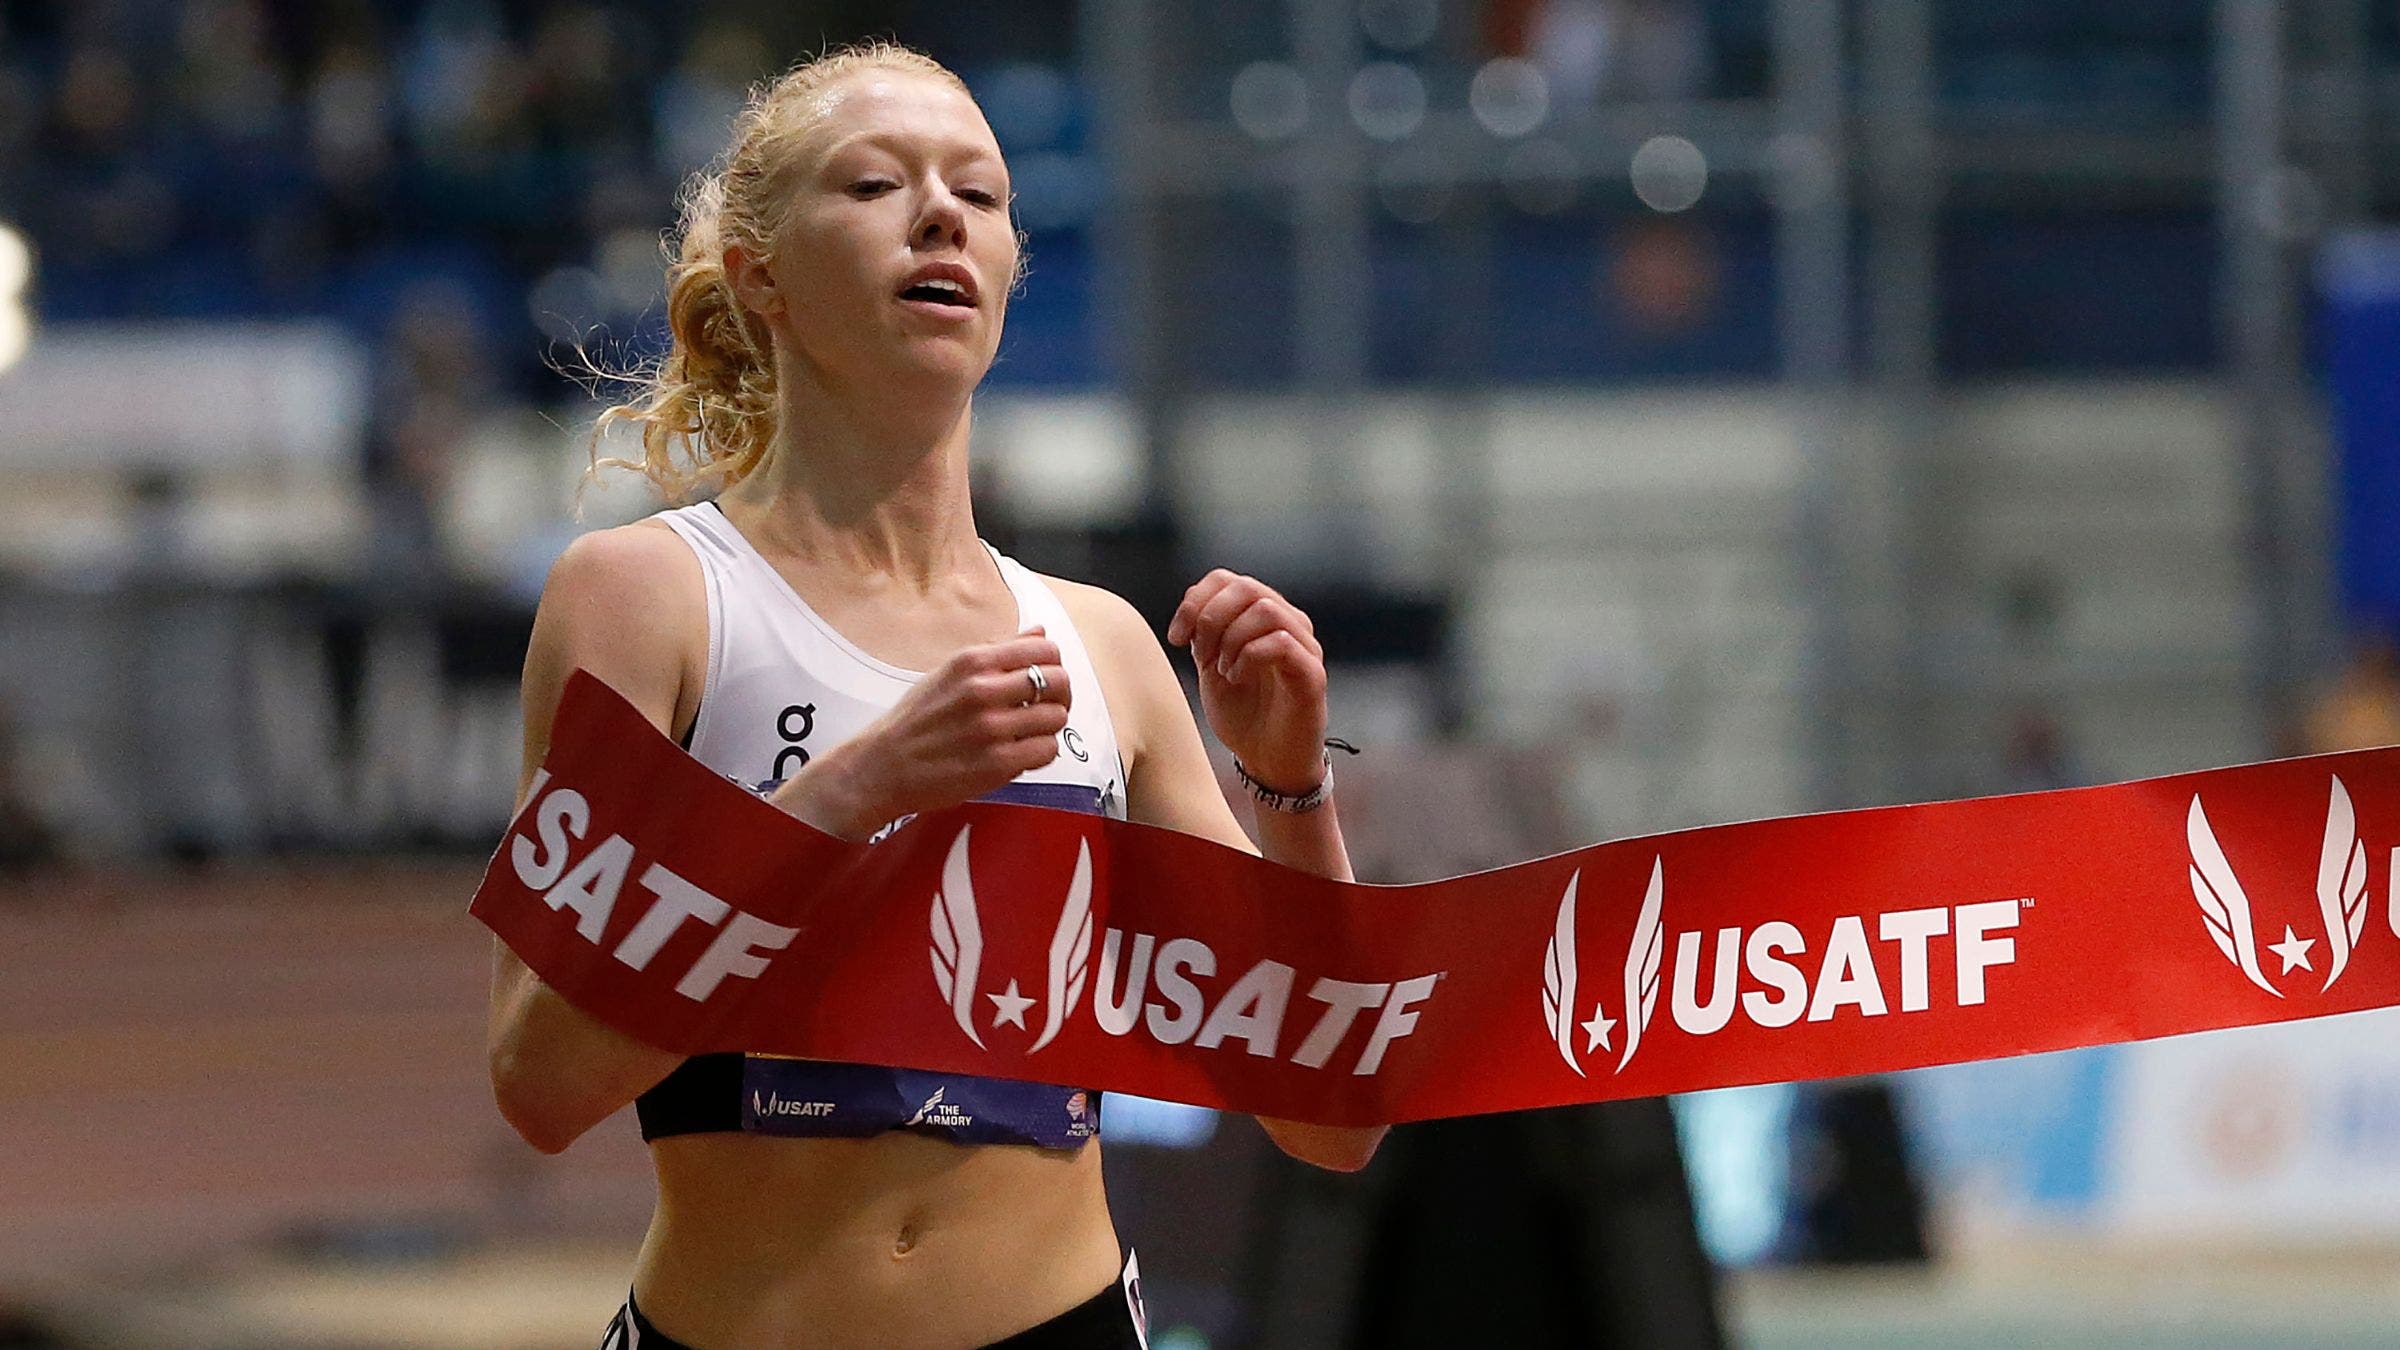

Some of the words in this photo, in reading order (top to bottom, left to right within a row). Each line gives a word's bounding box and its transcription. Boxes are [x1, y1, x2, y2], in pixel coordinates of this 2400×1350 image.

[511, 766, 801, 1003] SATF
[1094, 927, 1439, 1076] USATF
[1671, 899, 2021, 1035] USATF
[778, 1100, 836, 1117] USATF
[926, 1114, 973, 1127] ARMORY
[938, 1104, 960, 1116] THE
